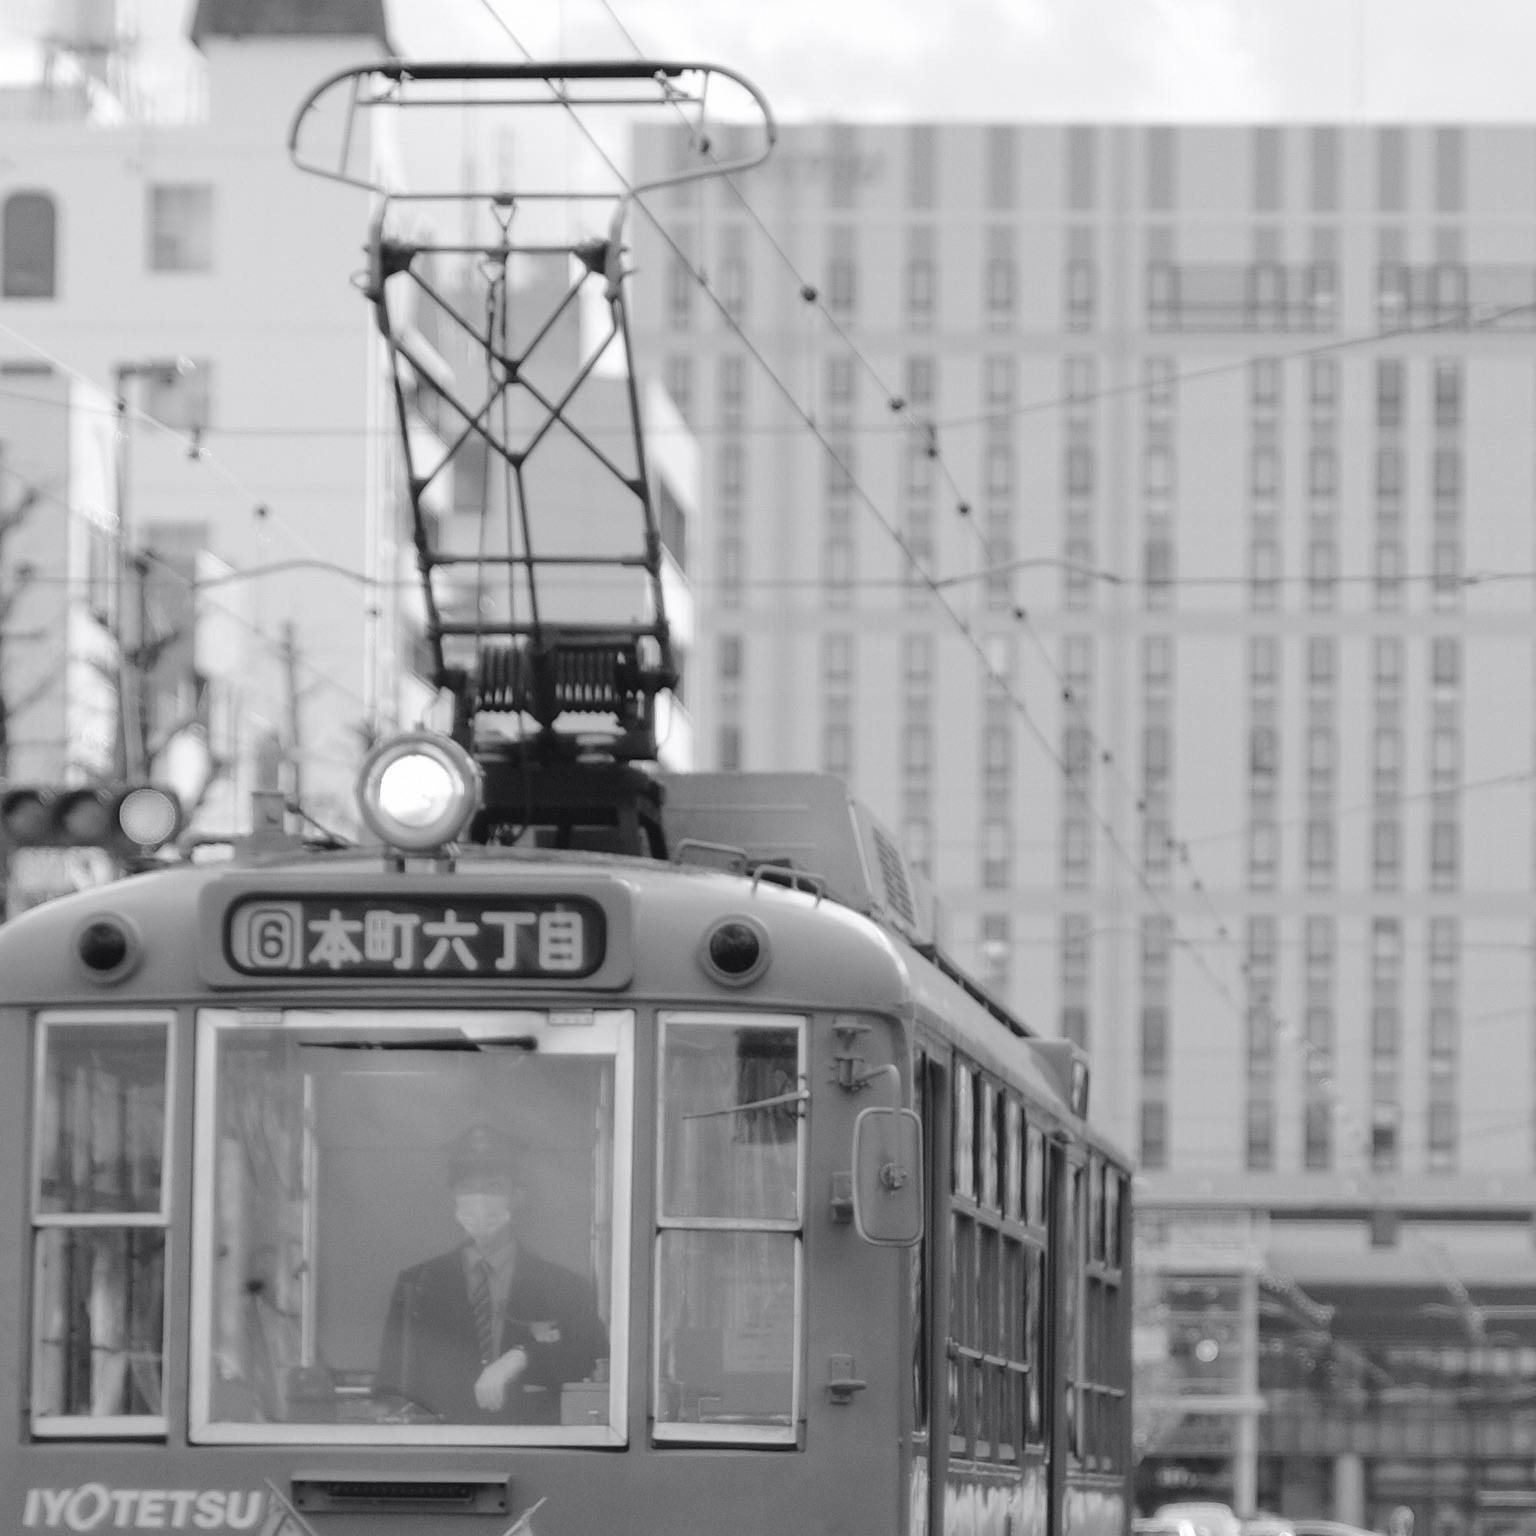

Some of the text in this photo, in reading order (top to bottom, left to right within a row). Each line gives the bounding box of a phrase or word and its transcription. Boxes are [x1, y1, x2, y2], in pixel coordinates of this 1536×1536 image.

[308, 908, 583, 970] 本町六丁目
[23, 1482, 263, 1531] IYOTETSU
